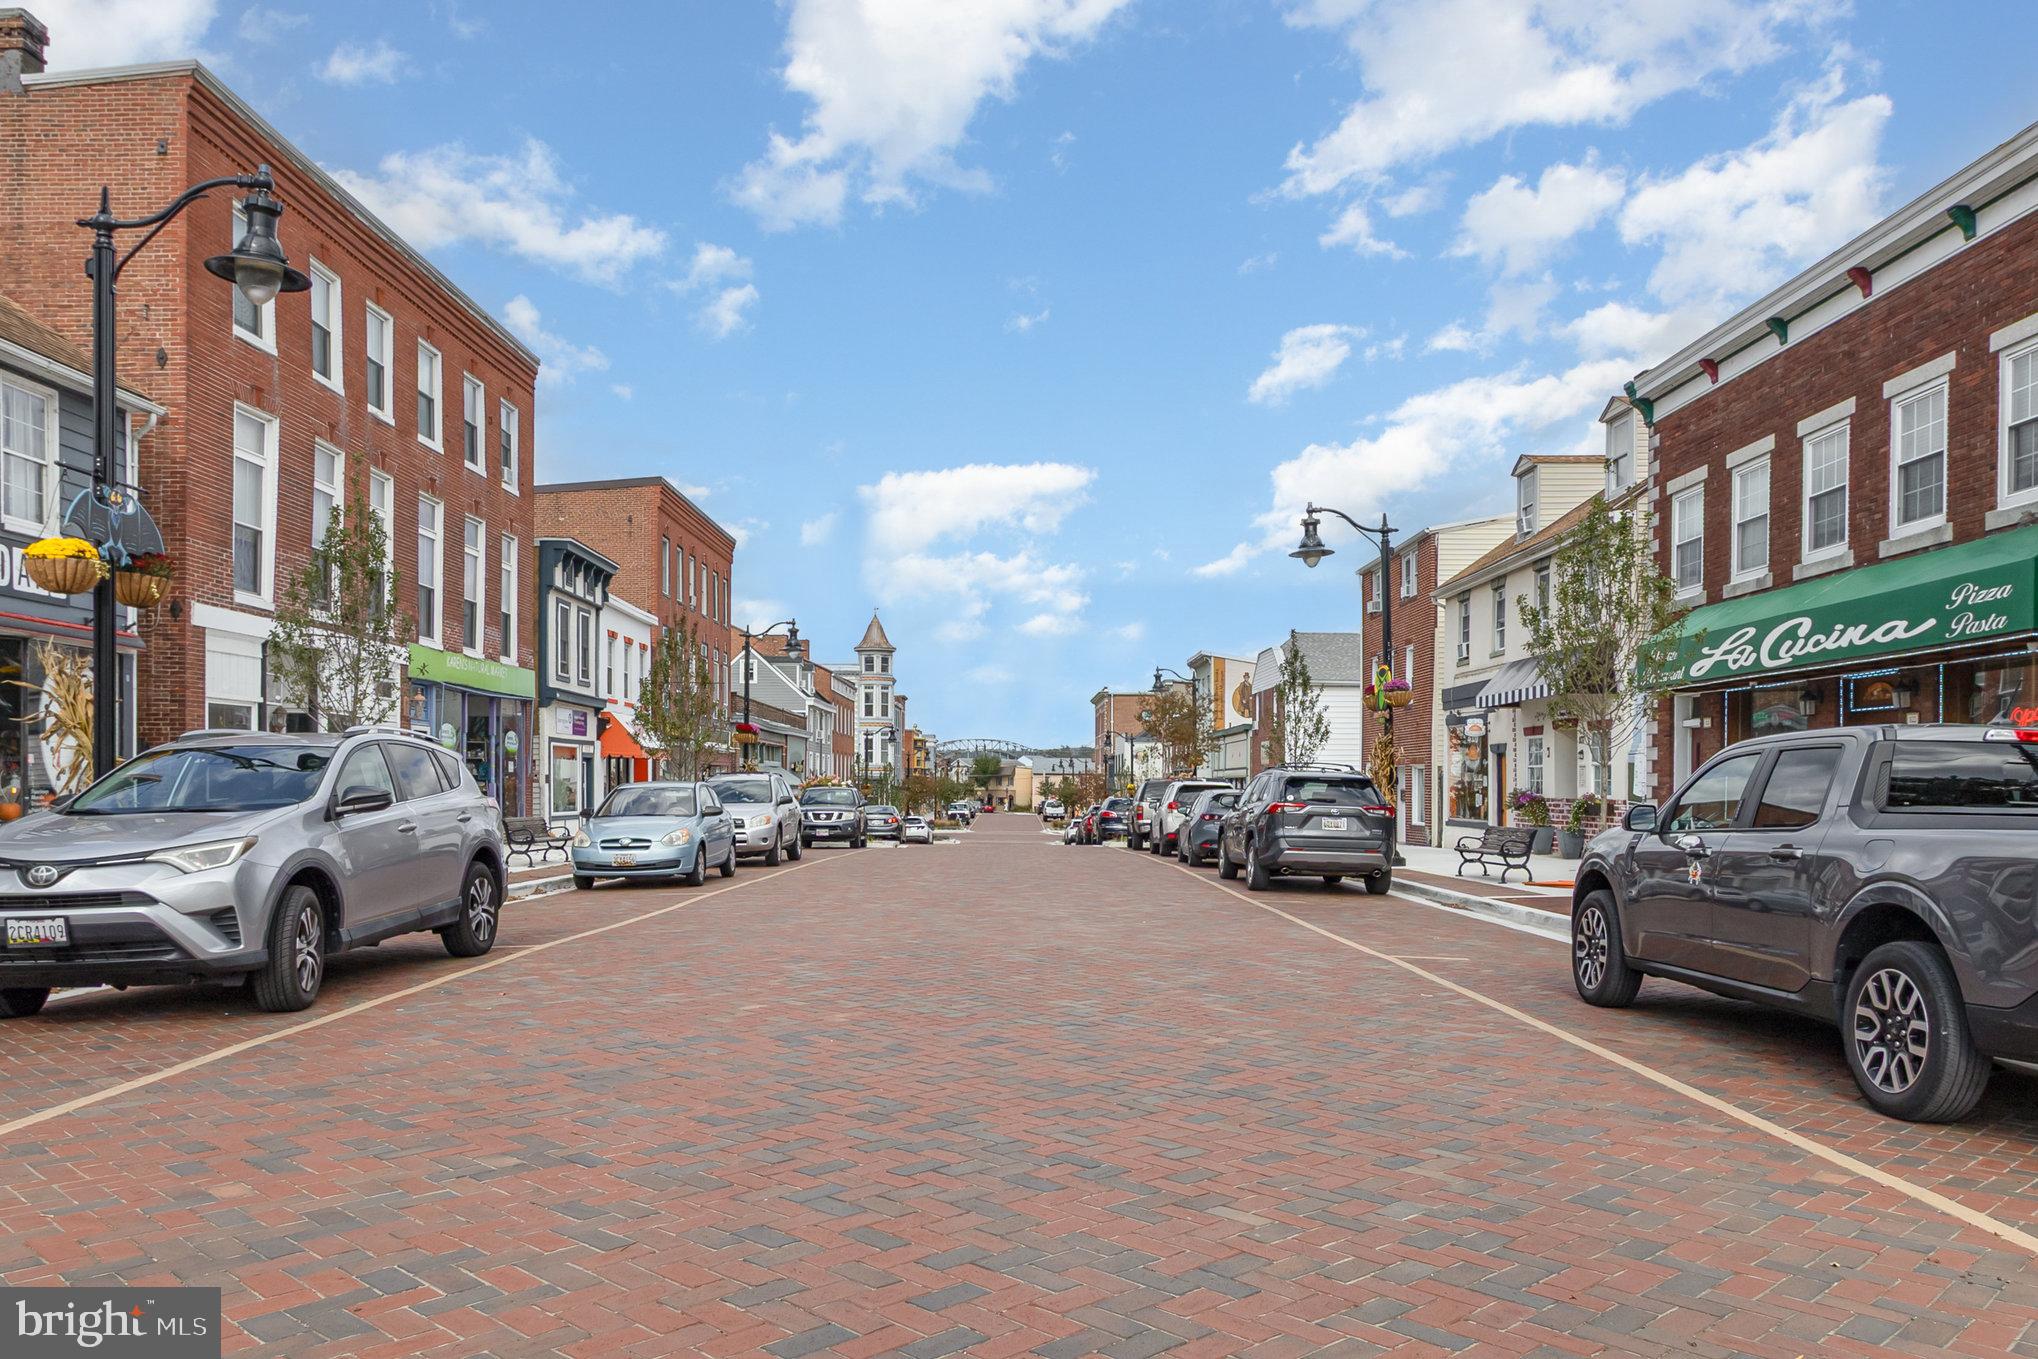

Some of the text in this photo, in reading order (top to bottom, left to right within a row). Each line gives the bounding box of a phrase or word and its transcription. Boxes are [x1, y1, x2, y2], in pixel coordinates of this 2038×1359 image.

[1946, 582, 2013, 610] Pizza
[1946, 611, 2008, 639] Pasta
[1690, 616, 1937, 677] La Cucina
